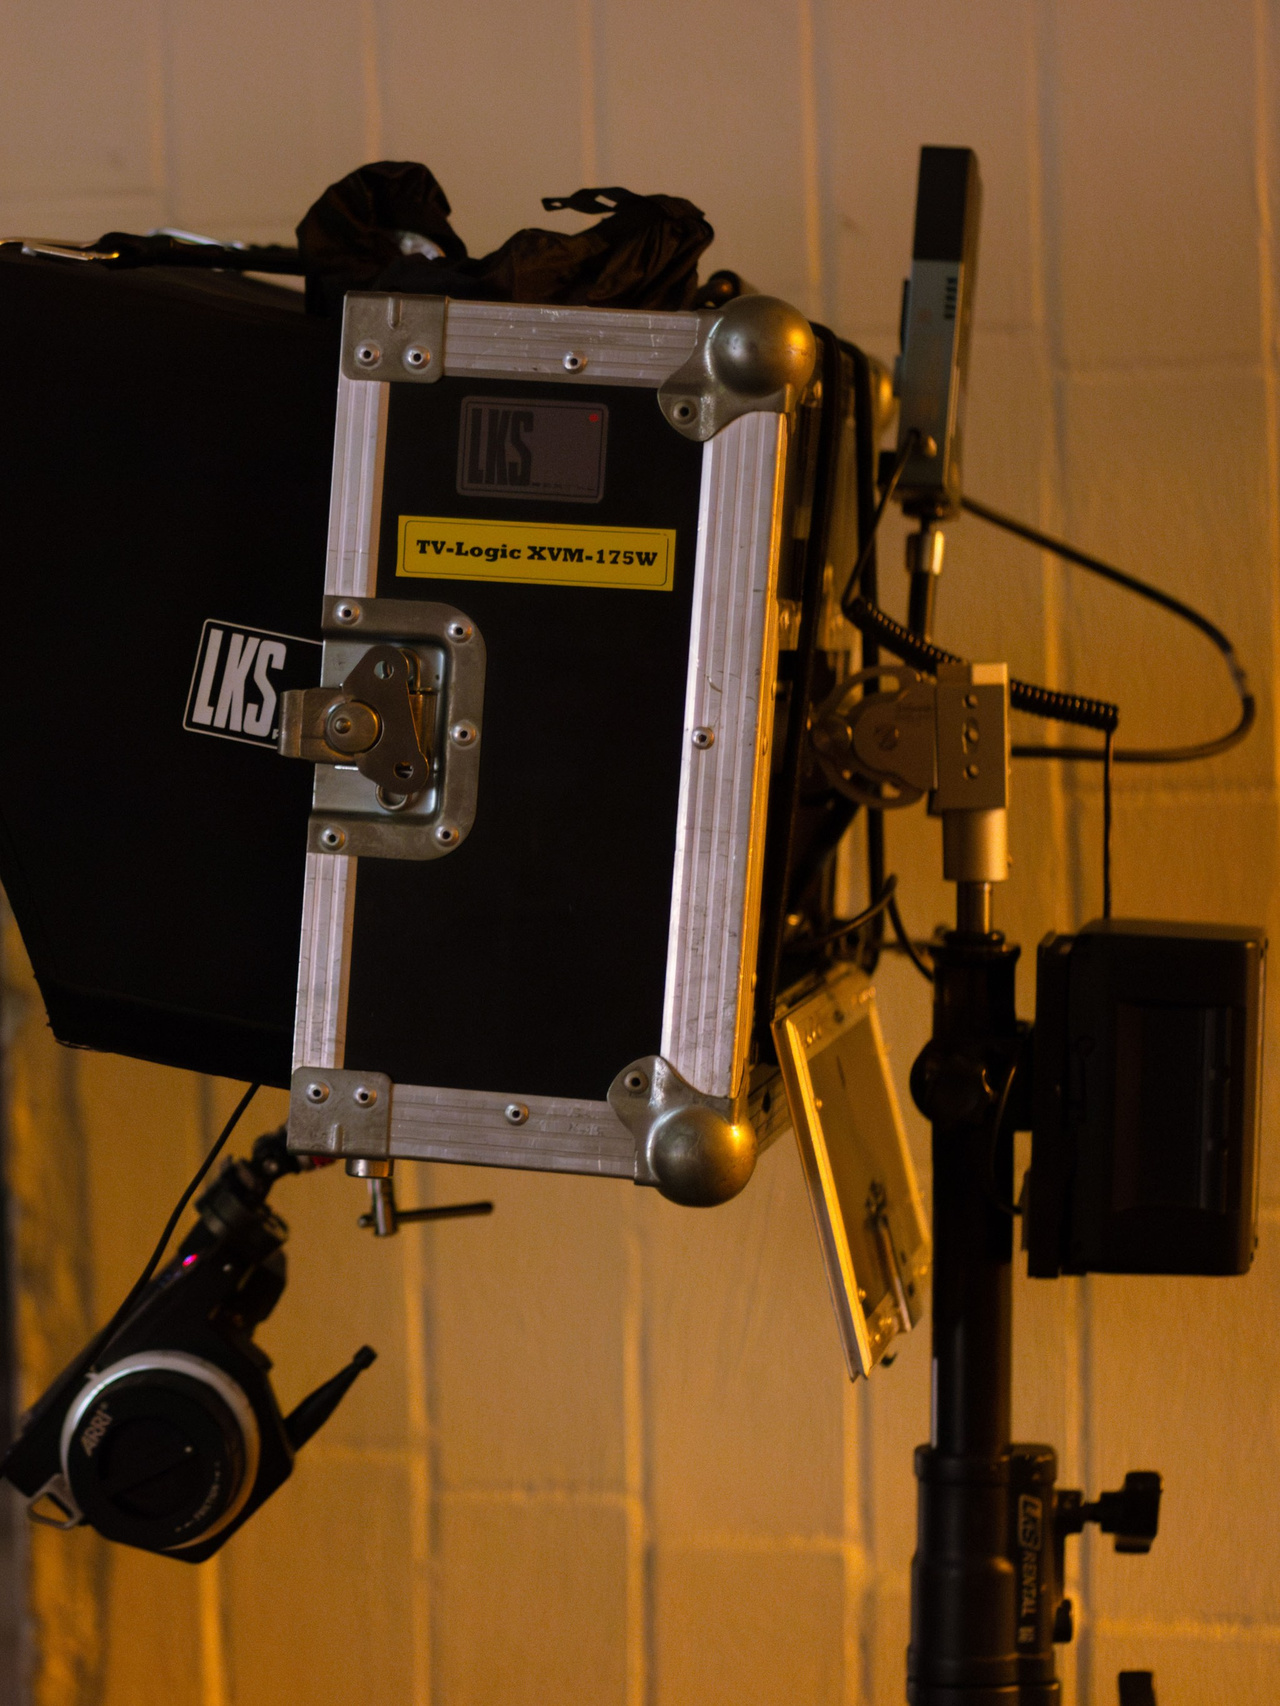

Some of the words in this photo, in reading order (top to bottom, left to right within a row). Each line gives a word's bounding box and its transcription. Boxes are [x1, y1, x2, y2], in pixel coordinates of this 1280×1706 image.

[468, 408, 533, 487] LKS
[416, 539, 522, 563] TV-Logic
[526, 545, 659, 567] XVM-175W
[191, 627, 288, 738] LKS
[1022, 1499, 1039, 1547] LKS
[1021, 1551, 1039, 1617] RENTAL
